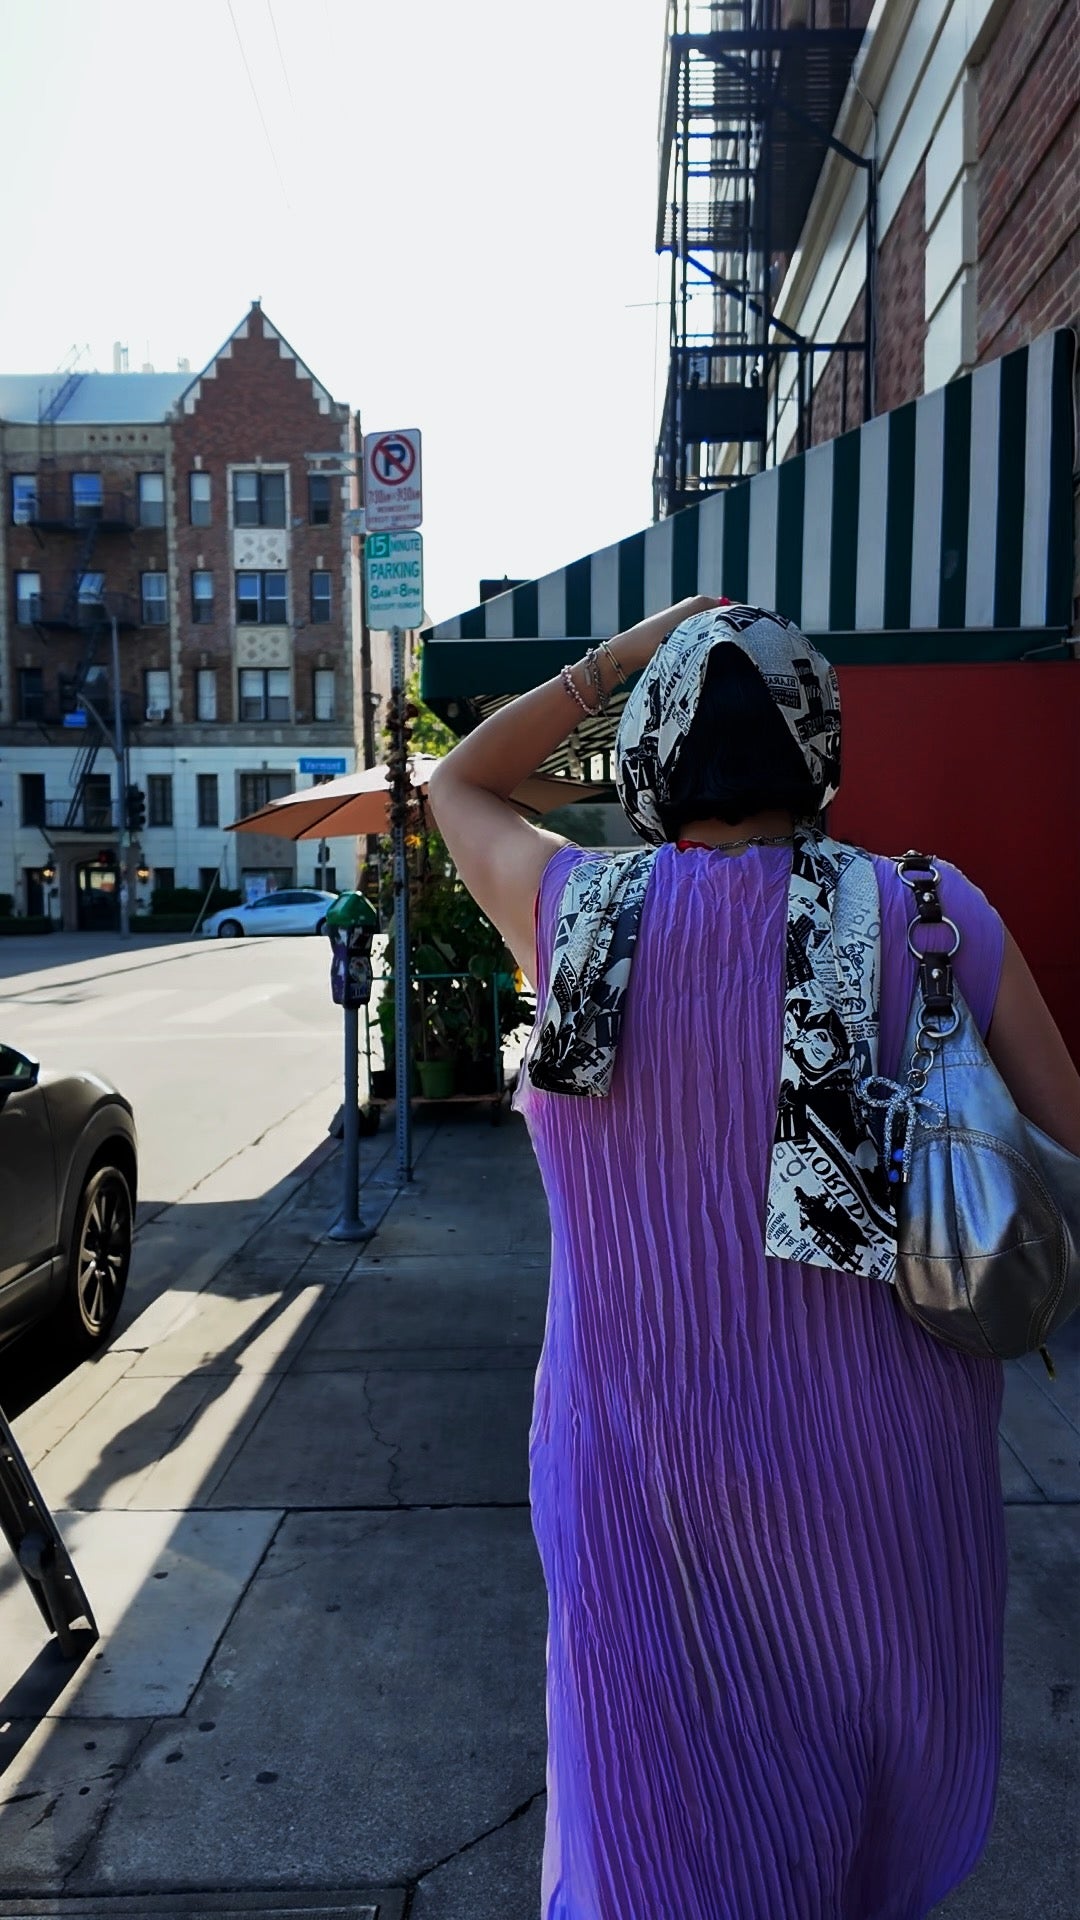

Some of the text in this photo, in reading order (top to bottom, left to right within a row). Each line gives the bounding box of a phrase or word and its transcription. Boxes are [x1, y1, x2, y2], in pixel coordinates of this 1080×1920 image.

[370, 536, 420, 556] 15 MINUTE
[371, 561, 420, 580] PARKING
